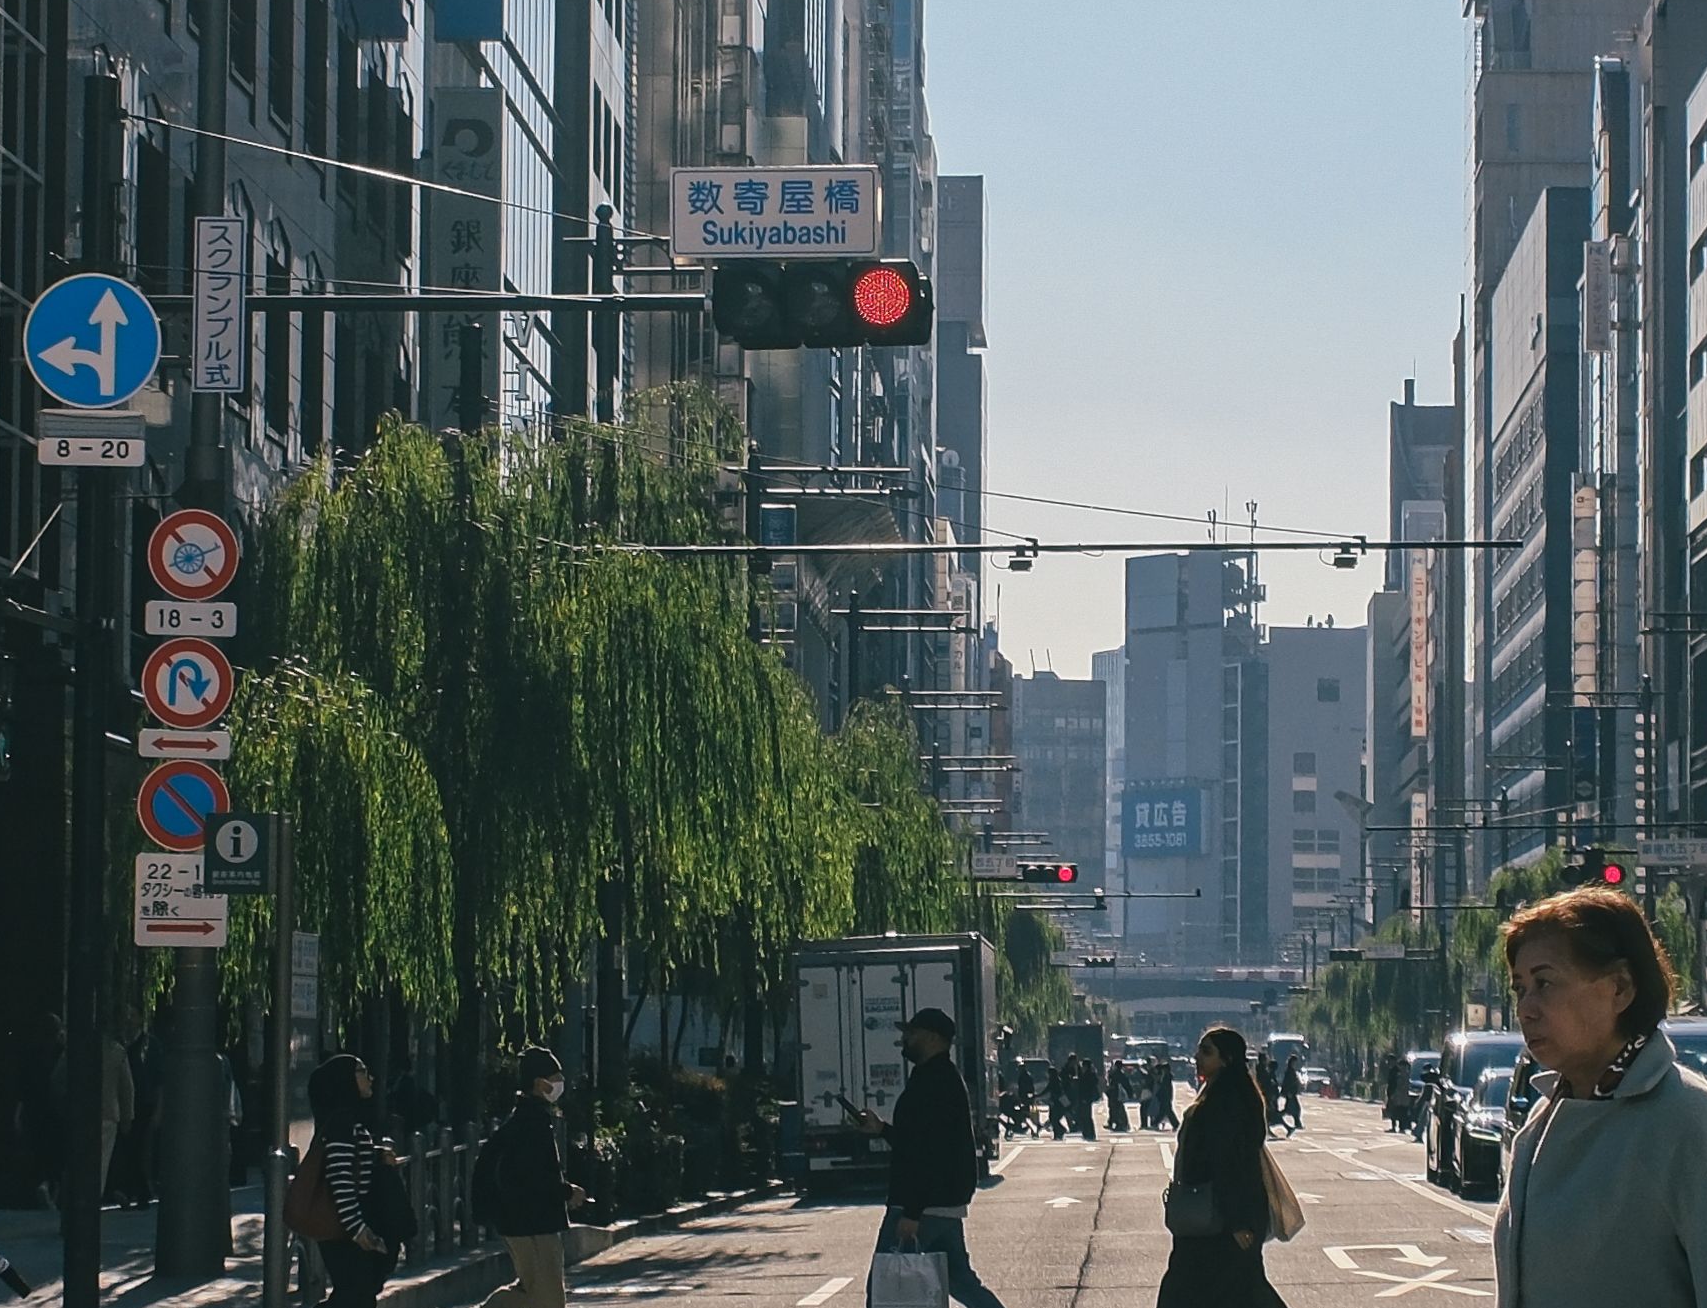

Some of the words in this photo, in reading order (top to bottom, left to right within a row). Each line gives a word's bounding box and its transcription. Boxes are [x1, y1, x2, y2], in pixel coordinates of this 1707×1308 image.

[688, 178, 861, 216] 数寄屋橋
[702, 219, 847, 251] Sukiyabashi
[204, 224, 234, 386] スクランブル式
[1135, 800, 1187, 828] 貸広告
